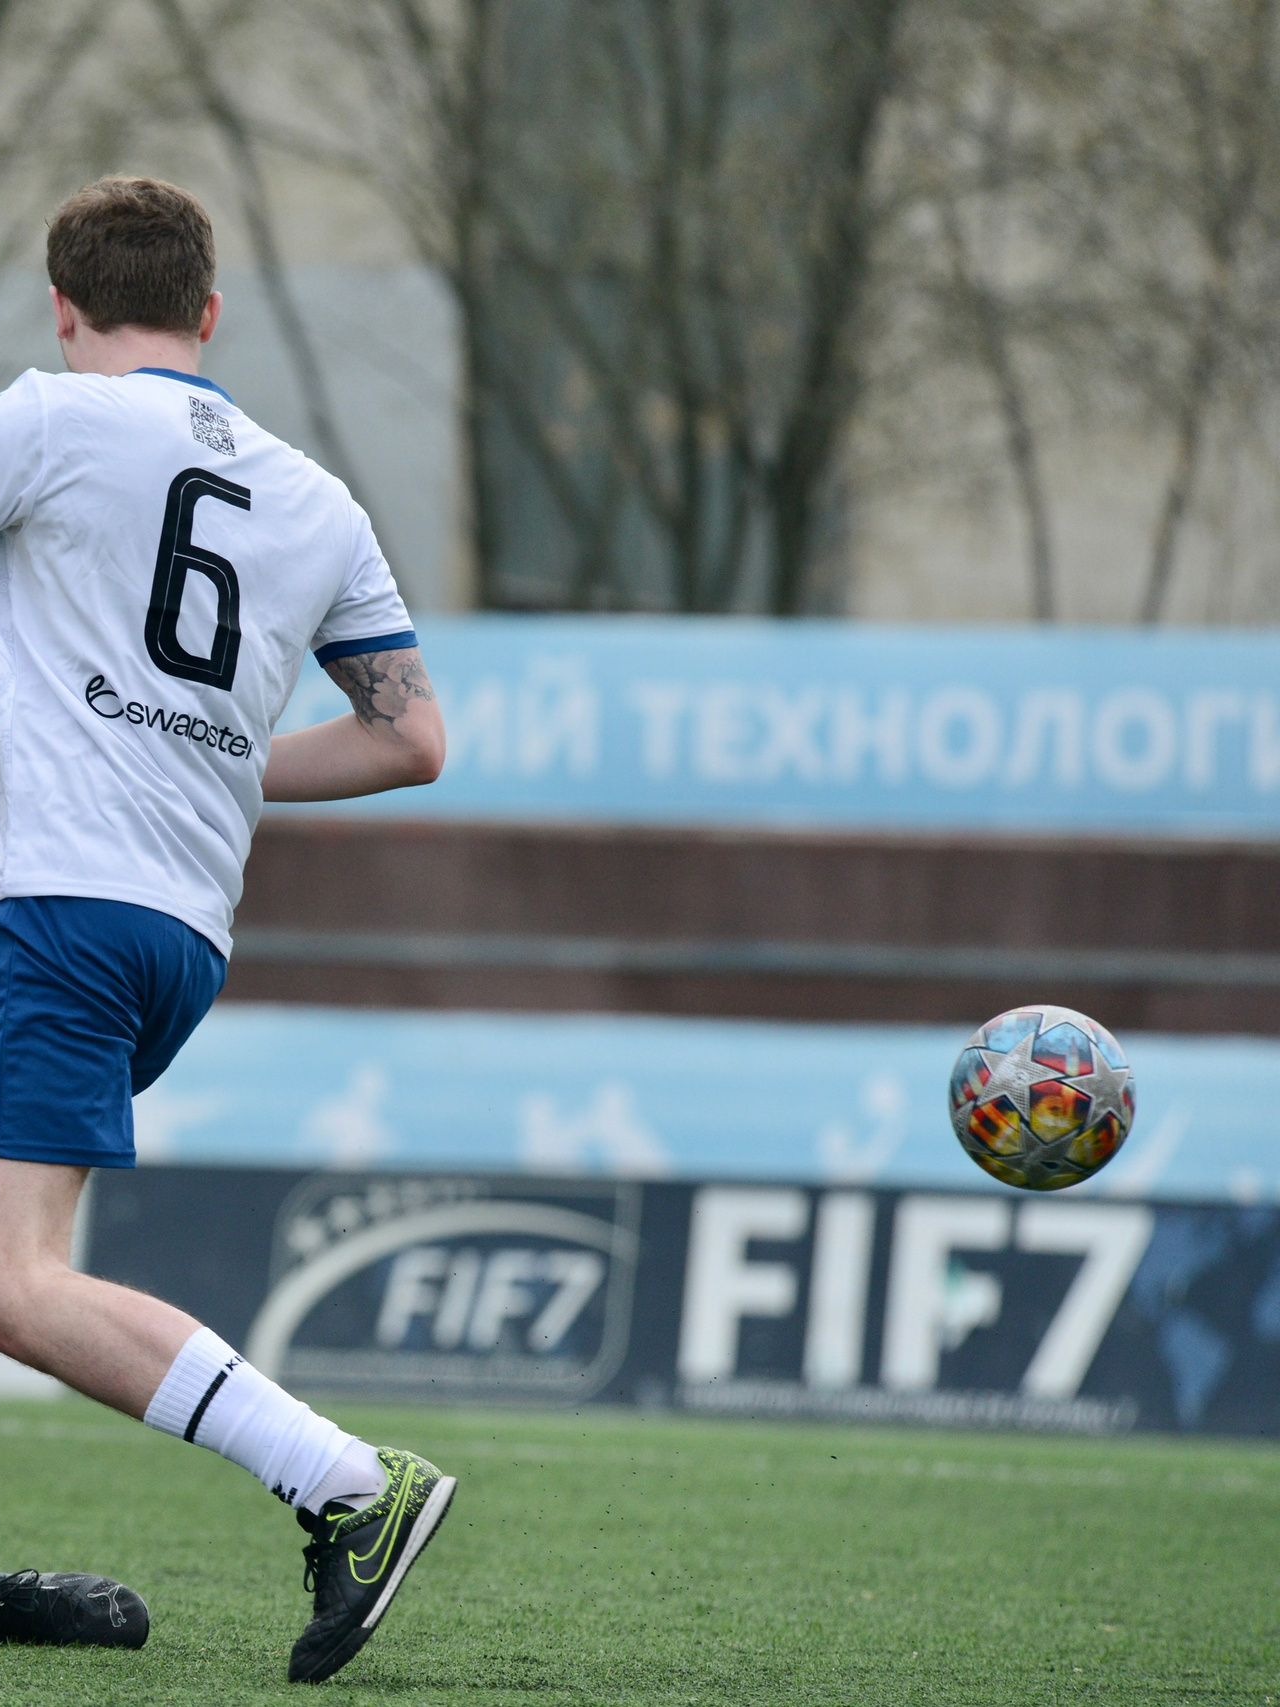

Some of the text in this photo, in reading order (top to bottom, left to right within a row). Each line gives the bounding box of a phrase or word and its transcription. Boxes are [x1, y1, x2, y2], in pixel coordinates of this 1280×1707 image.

[144, 467, 251, 692] 6
[125, 700, 257, 760] swapster
[376, 1247, 604, 1350] FIF7
[680, 1188, 1153, 1400] FIF7
